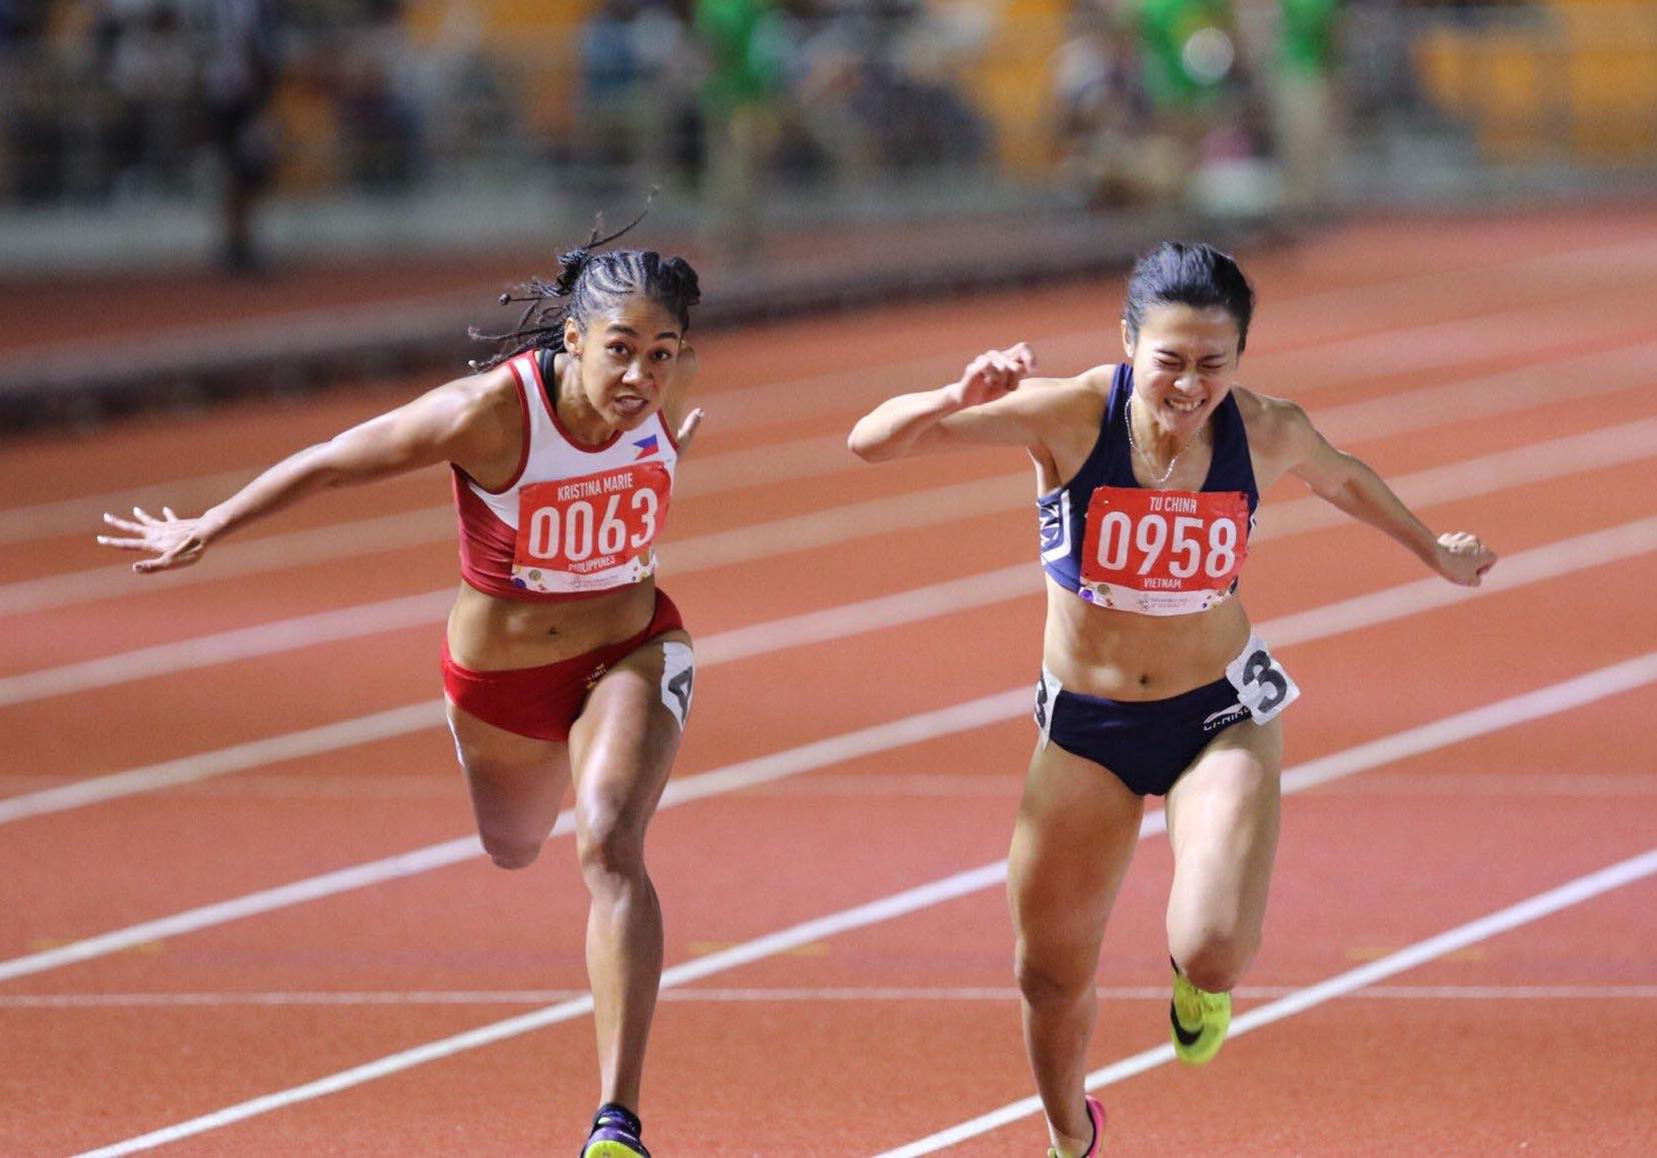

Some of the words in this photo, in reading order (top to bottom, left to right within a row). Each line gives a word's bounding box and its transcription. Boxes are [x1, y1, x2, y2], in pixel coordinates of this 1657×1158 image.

[557, 479, 602, 502] KRISTINA
[603, 472, 633, 493] MARIE
[1150, 496, 1163, 511] TU
[529, 488, 657, 561] 0063
[1097, 511, 1237, 578] 0958
[1144, 577, 1182, 589] VIETNAM
[1242, 650, 1287, 713] 3
